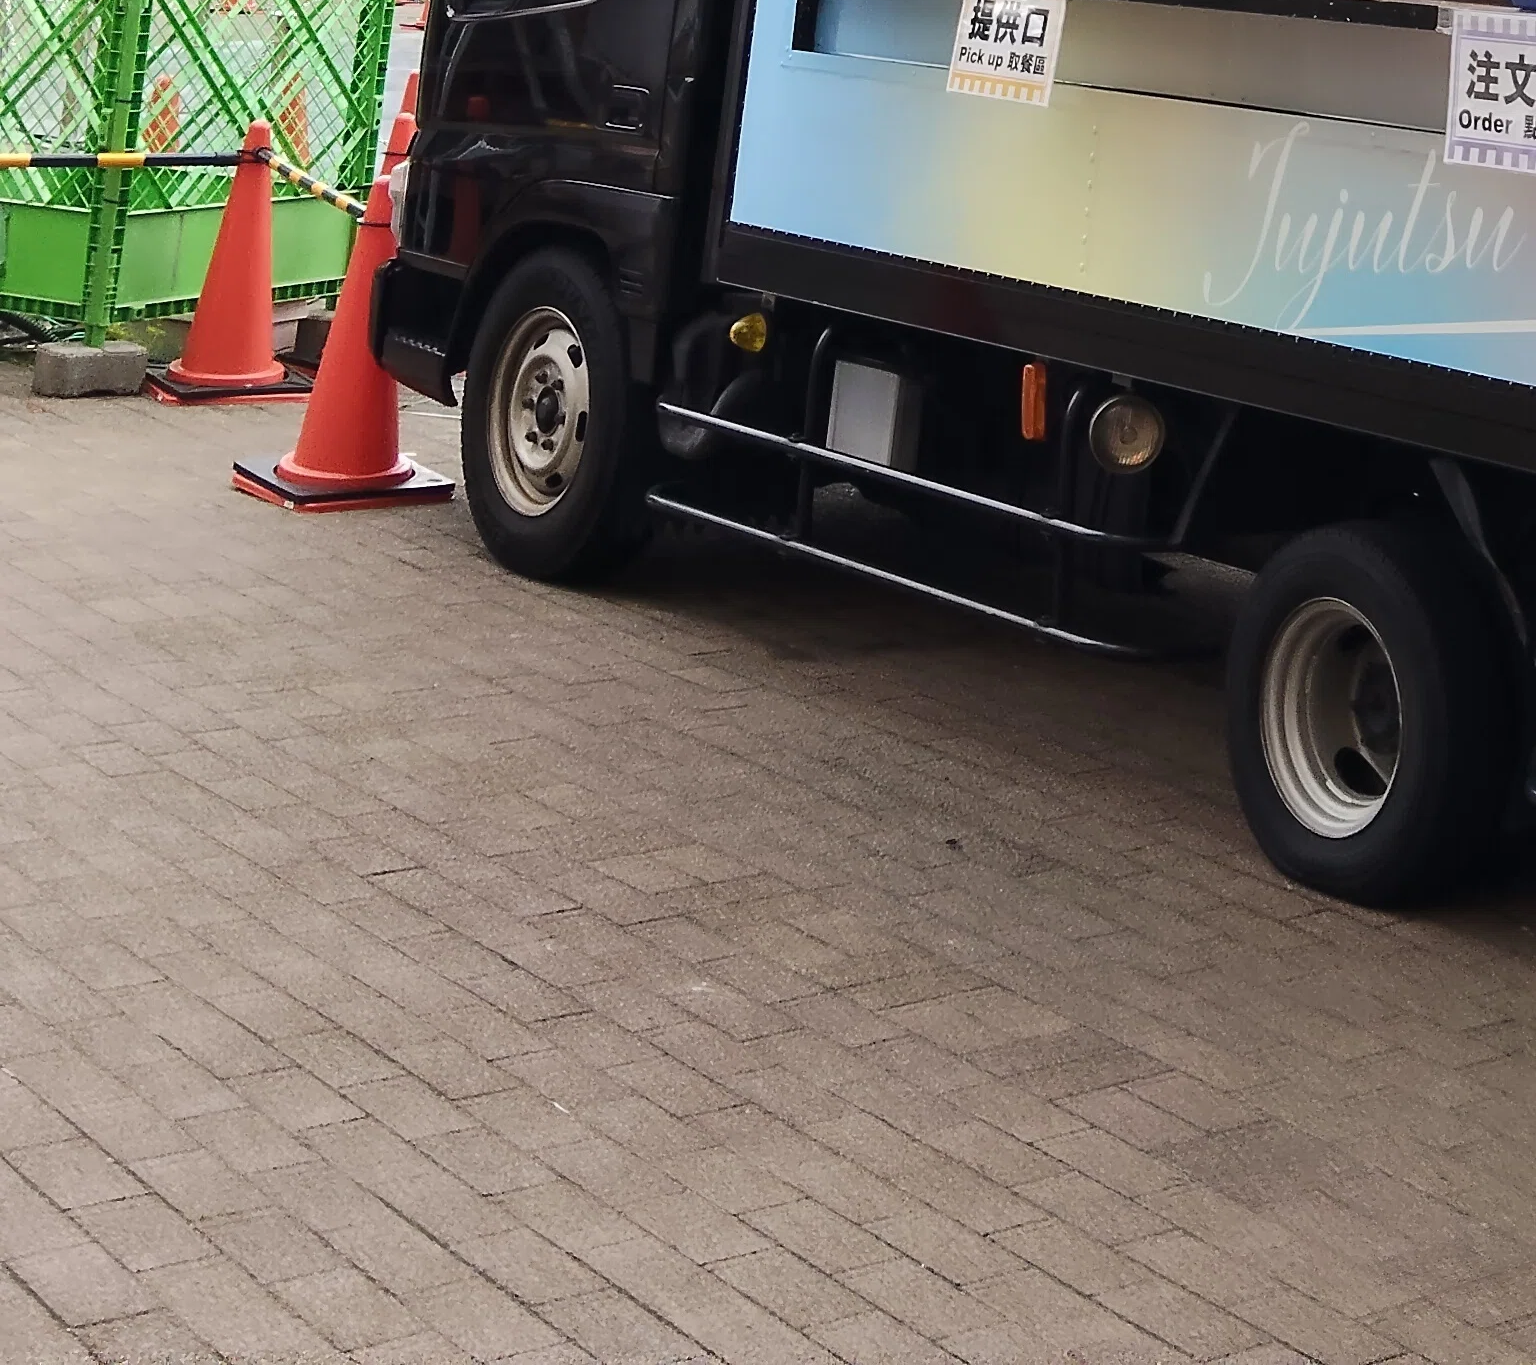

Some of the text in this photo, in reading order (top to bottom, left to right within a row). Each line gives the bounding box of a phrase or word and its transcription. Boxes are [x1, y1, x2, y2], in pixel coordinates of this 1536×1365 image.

[958, 46, 1048, 76] Pick up 取餐區
[1458, 108, 1514, 135] Order
[1203, 121, 1528, 329] Jujutsu
